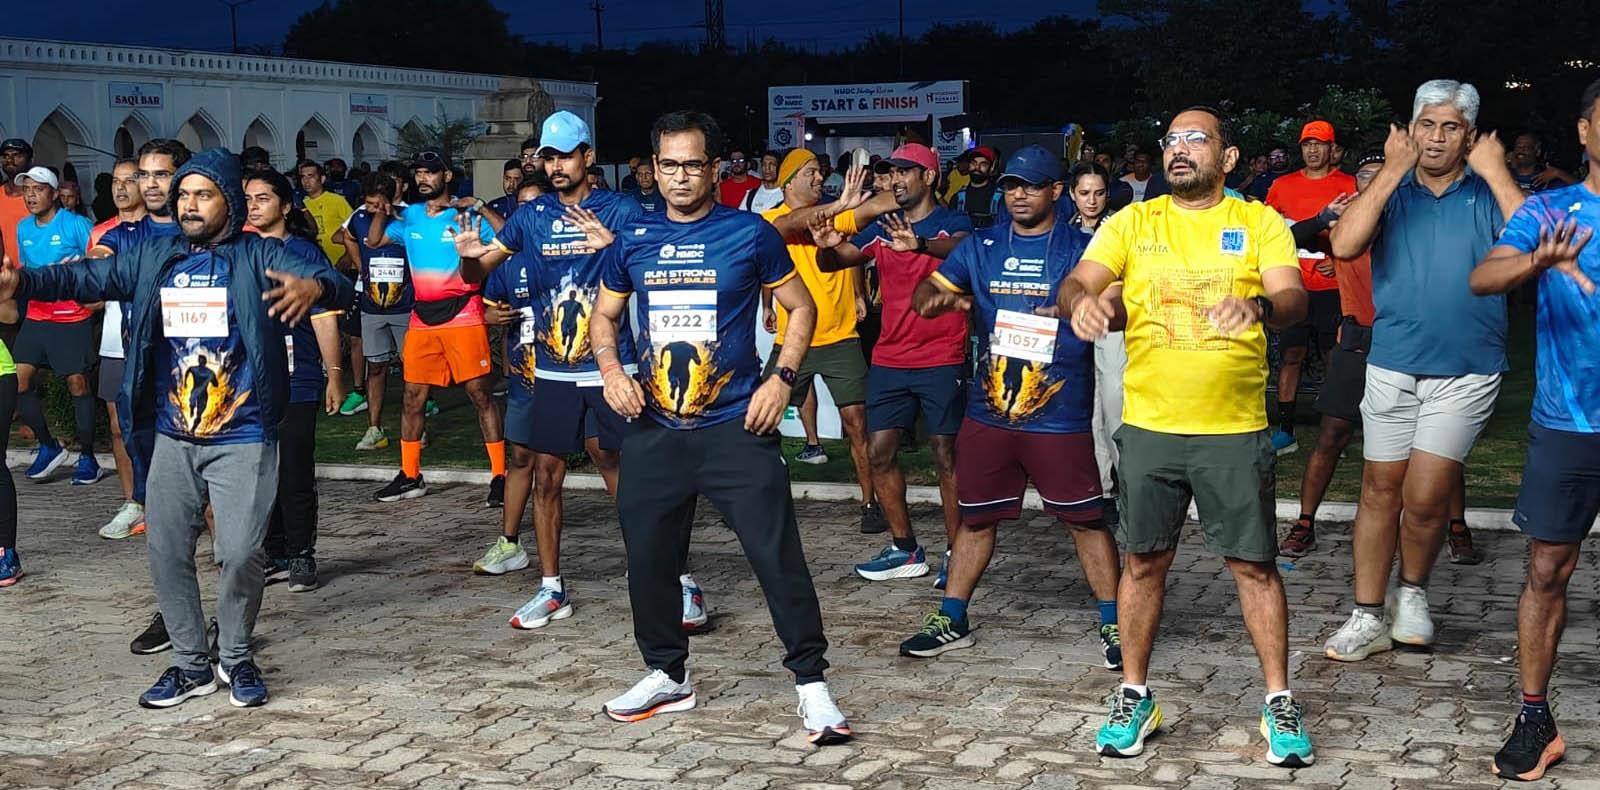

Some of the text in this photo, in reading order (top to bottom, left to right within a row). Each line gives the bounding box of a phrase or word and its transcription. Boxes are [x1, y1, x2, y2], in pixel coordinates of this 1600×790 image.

[115, 96, 160, 105] SAQI BAR
[811, 96, 918, 111] START & FINISH
[676, 250, 704, 258] NMDC
[644, 269, 717, 278] RUN STRONG
[990, 280, 1050, 290] RUN STRONG
[181, 312, 207, 324] 1169
[662, 314, 702, 328] 9222
[1008, 333, 1039, 348] 1057
